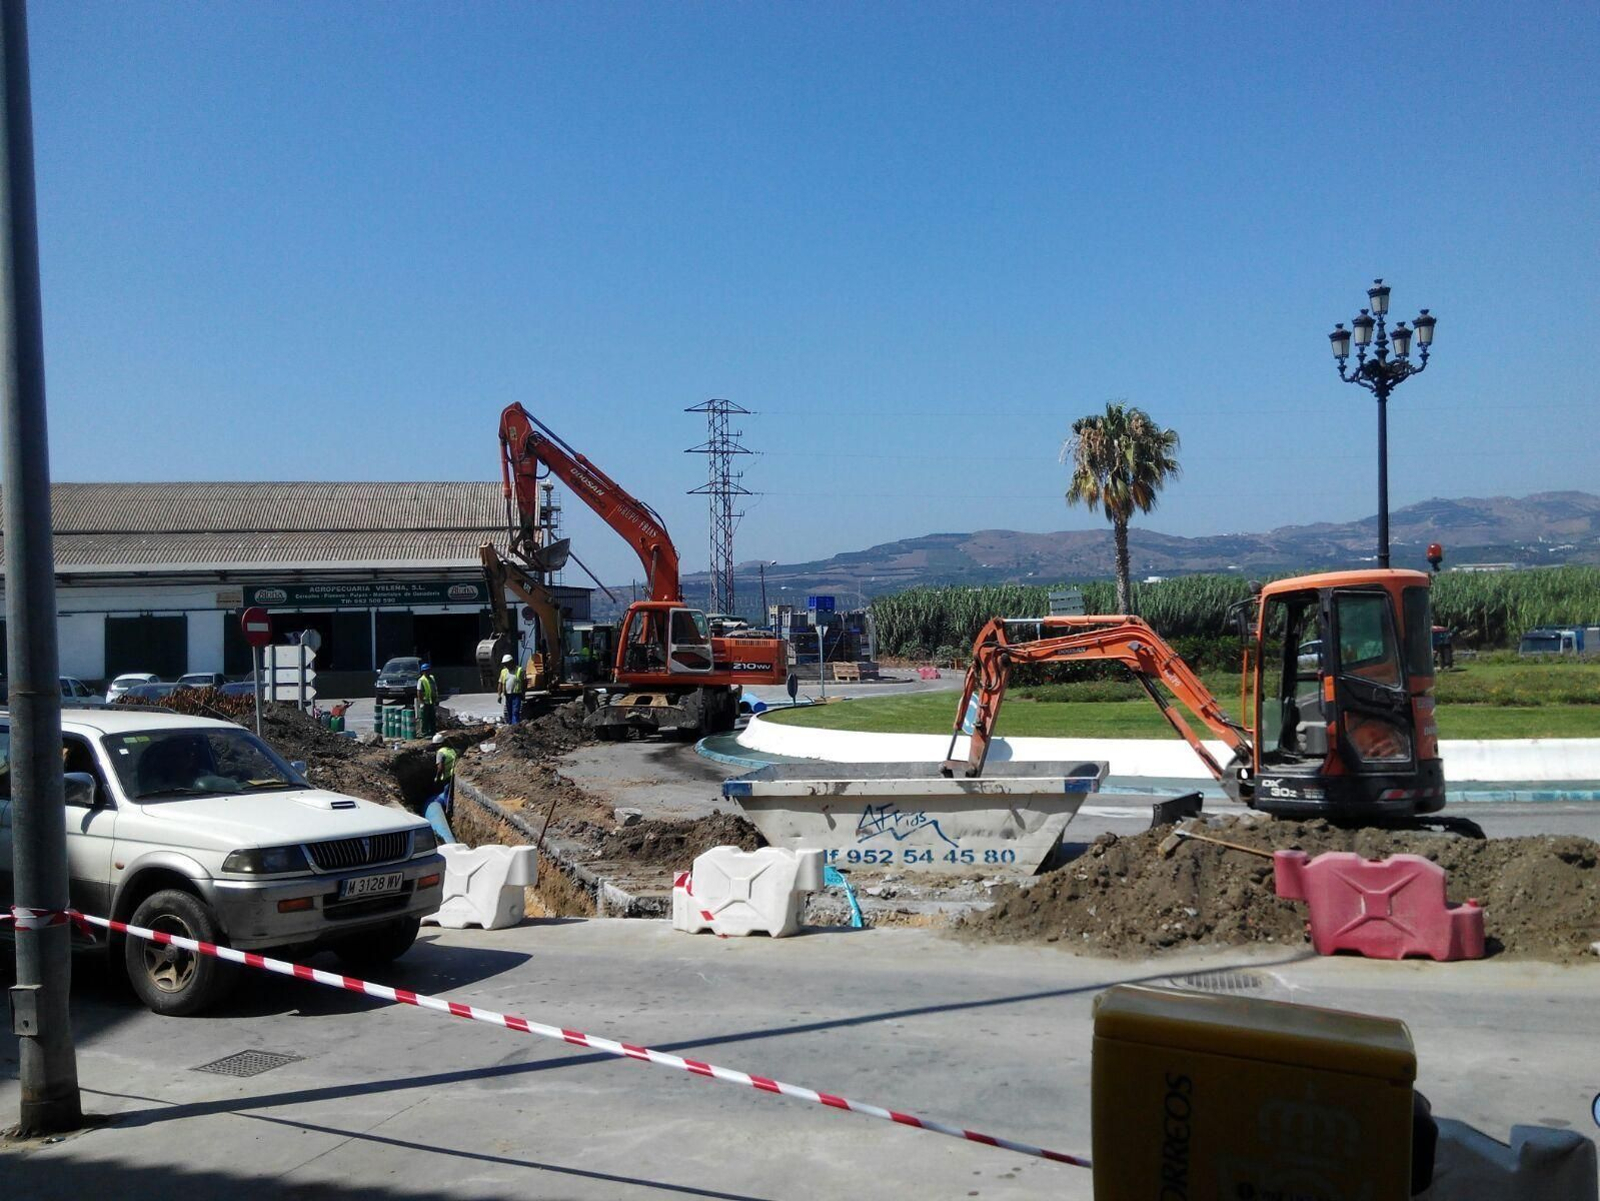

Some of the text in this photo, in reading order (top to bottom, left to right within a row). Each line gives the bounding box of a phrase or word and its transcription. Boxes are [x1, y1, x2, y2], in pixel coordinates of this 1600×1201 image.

[570, 467, 605, 496] DOOSAN
[309, 585, 371, 593] AGROPECUARIA
[1261, 778, 1284, 787] DX
[846, 849, 894, 864] 952
[904, 849, 935, 864] 54
[942, 849, 975, 864] 45
[984, 849, 1016, 864] 80
[358, 876, 386, 893] 3128
